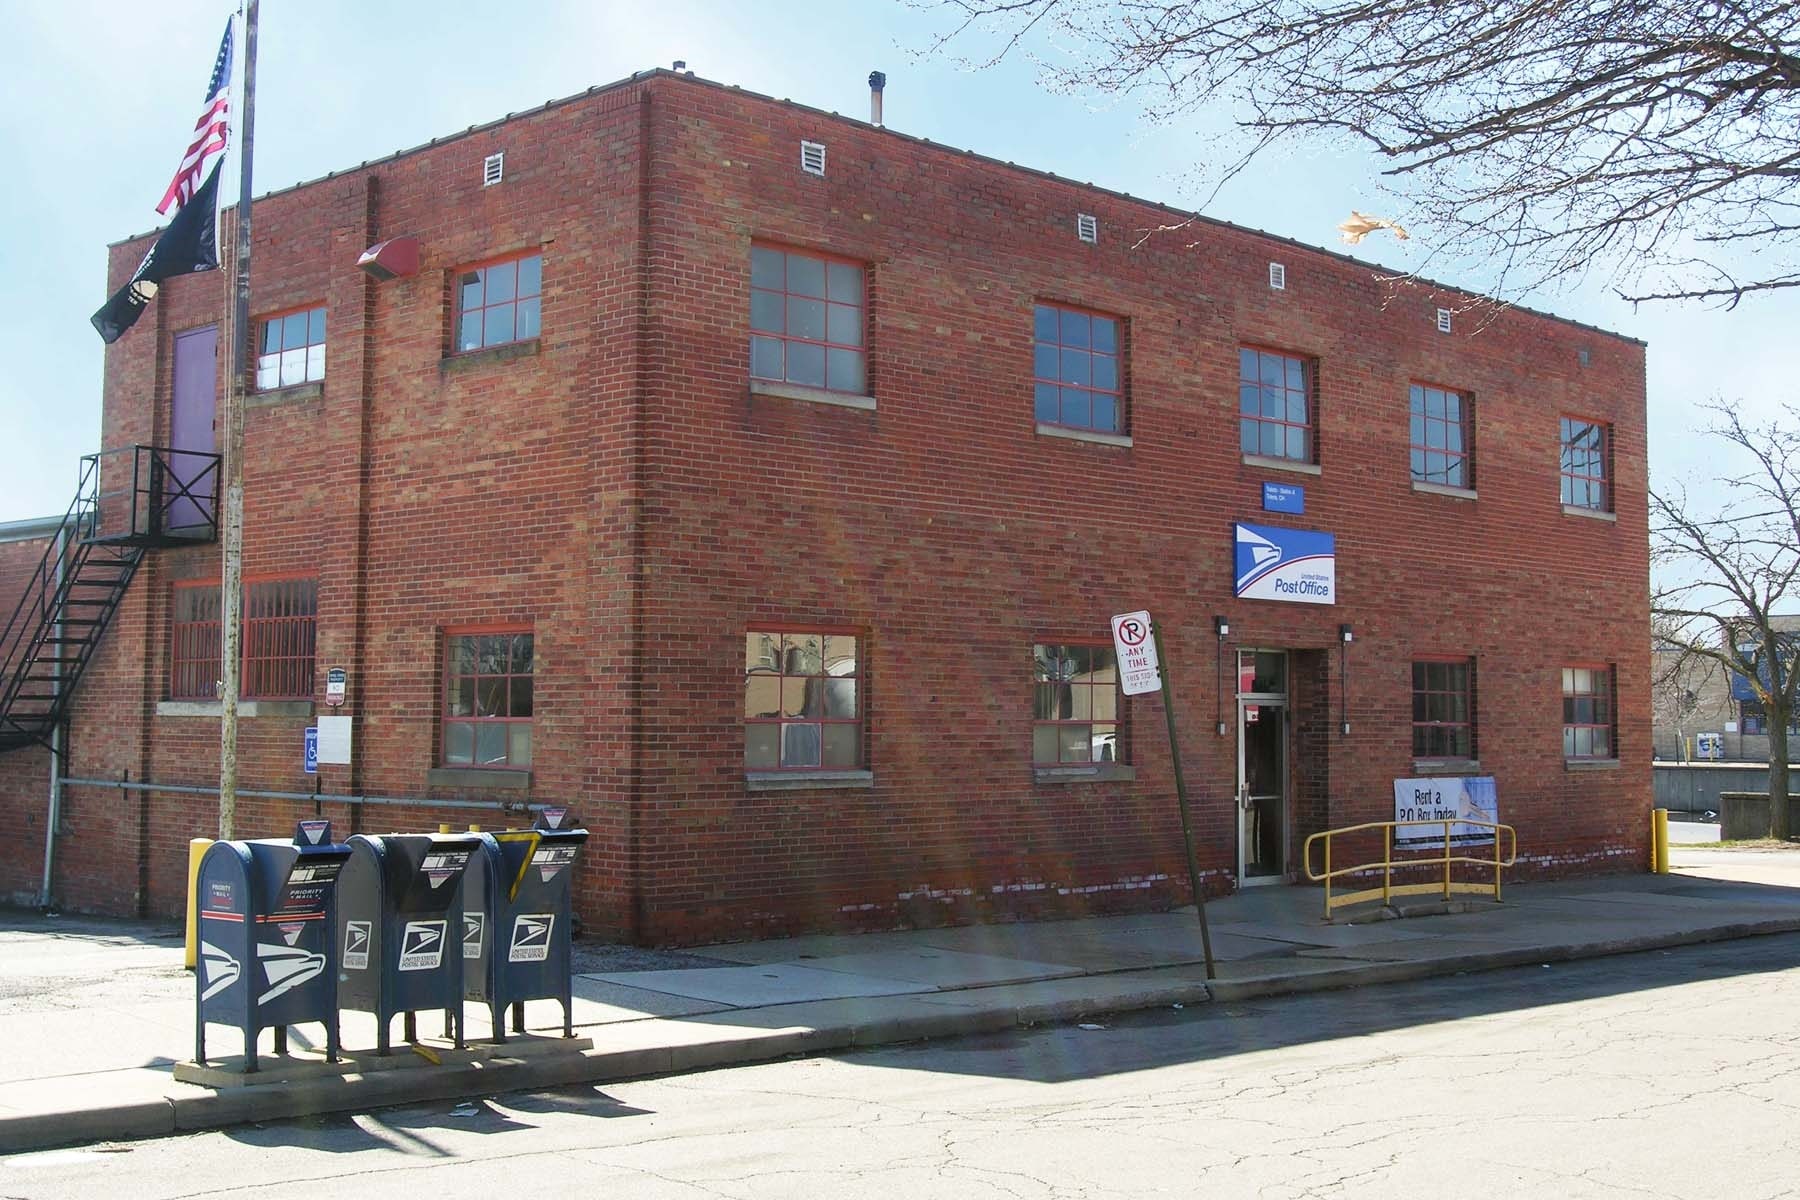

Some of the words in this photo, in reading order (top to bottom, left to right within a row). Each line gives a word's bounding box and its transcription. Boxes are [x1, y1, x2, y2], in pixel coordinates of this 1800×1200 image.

[1275, 578, 1298, 594] Post
[1299, 580, 1329, 596] Office
[1128, 647, 1145, 657] ANY
[1128, 658, 1149, 668] TIME
[1415, 789, 1432, 806] Rent
[1435, 791, 1442, 805] a
[1417, 807, 1431, 821] Box
[1433, 806, 1457, 826] today
[289, 888, 323, 896] PRIORITY
